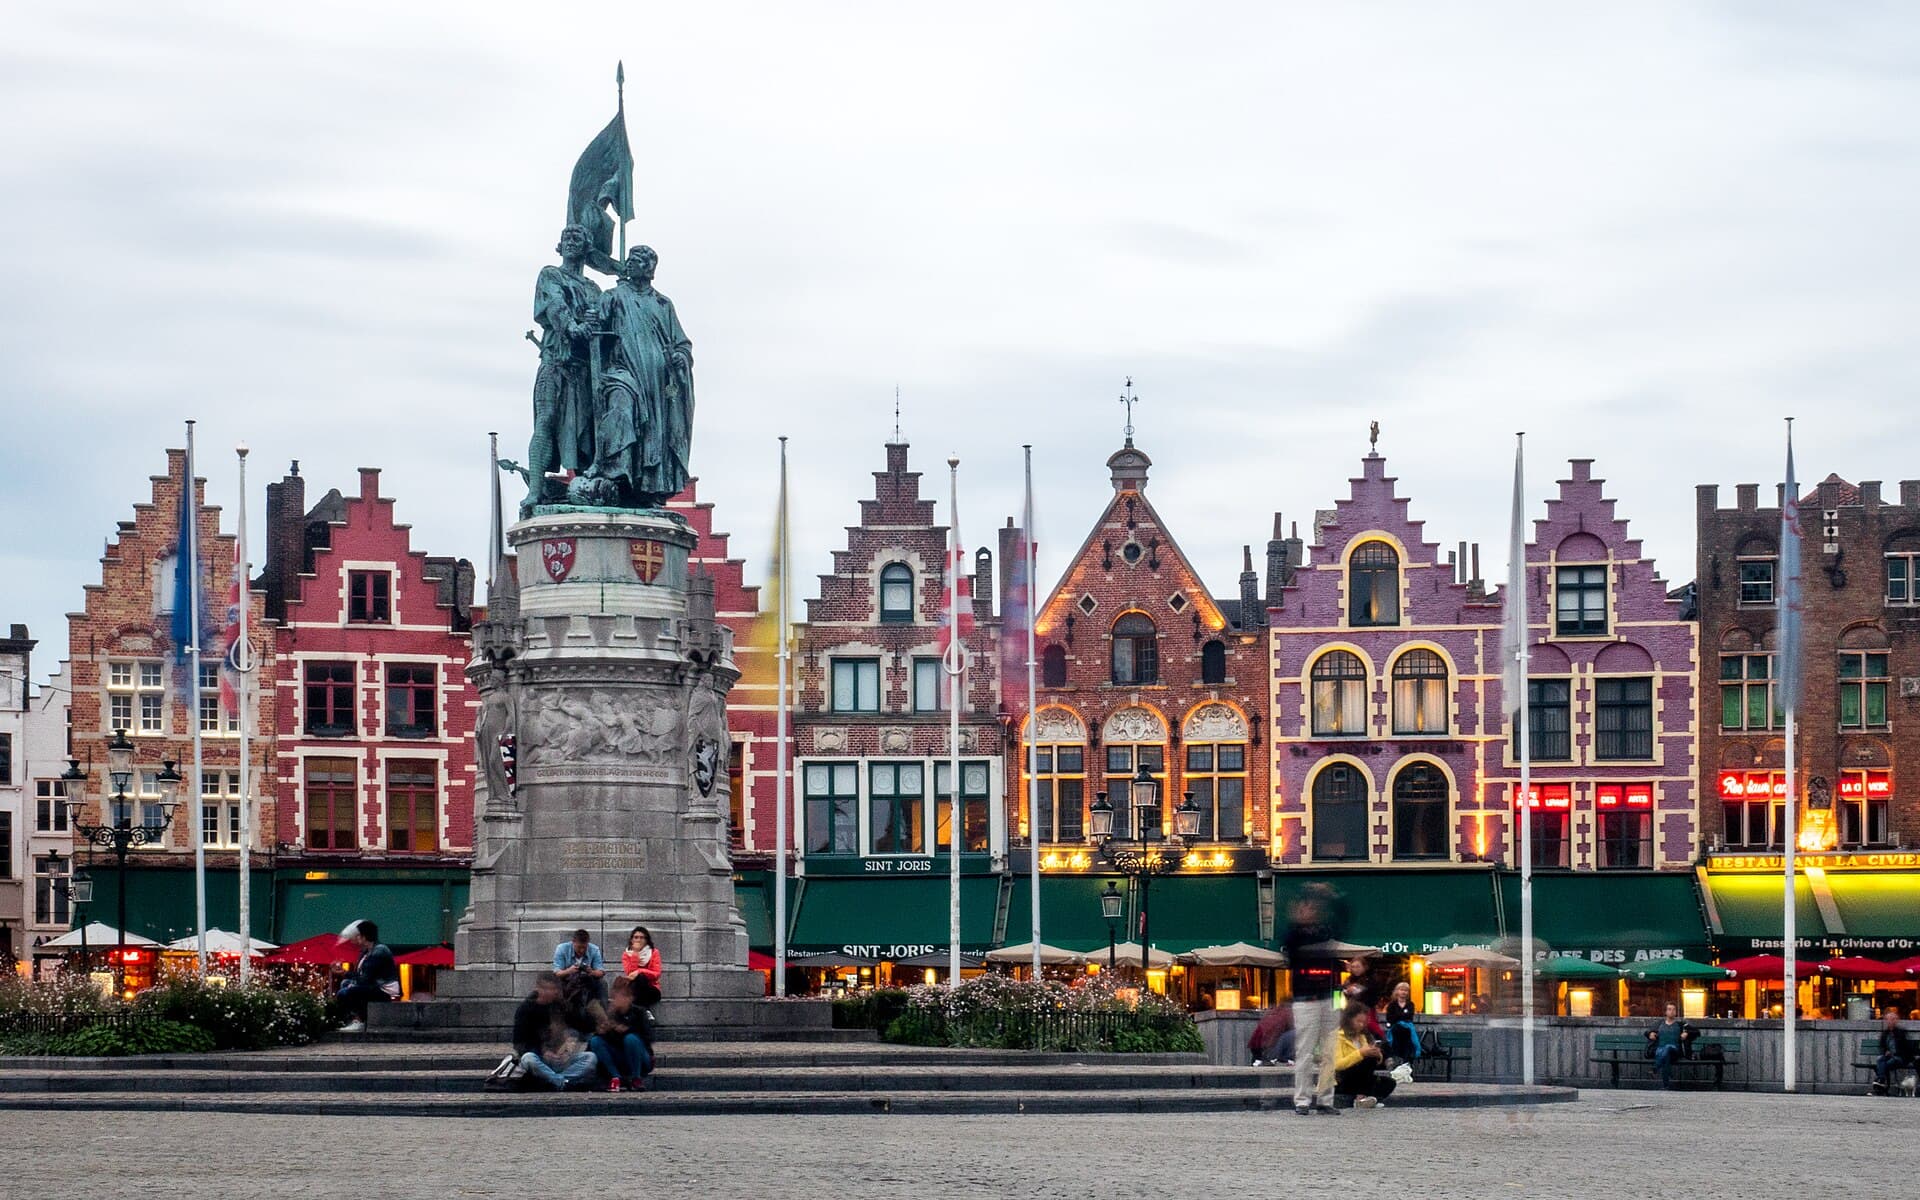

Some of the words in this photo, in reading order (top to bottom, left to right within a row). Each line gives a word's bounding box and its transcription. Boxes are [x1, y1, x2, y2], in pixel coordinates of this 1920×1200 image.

[1723, 776, 1788, 795] Restauran
[865, 860, 893, 871] SINT
[896, 860, 932, 871] JORIS
[1834, 855, 1858, 866] LA
[1382, 942, 1409, 953] d'Or
[1423, 943, 1448, 953] Pizza
[1752, 939, 1811, 948] Brassrie
[1823, 938, 1838, 948] La
[1887, 938, 1914, 948] d'Or
[843, 944, 934, 958] SINT-JORIS
[1590, 949, 1626, 962] DES
[1634, 948, 1684, 962] ARTS
